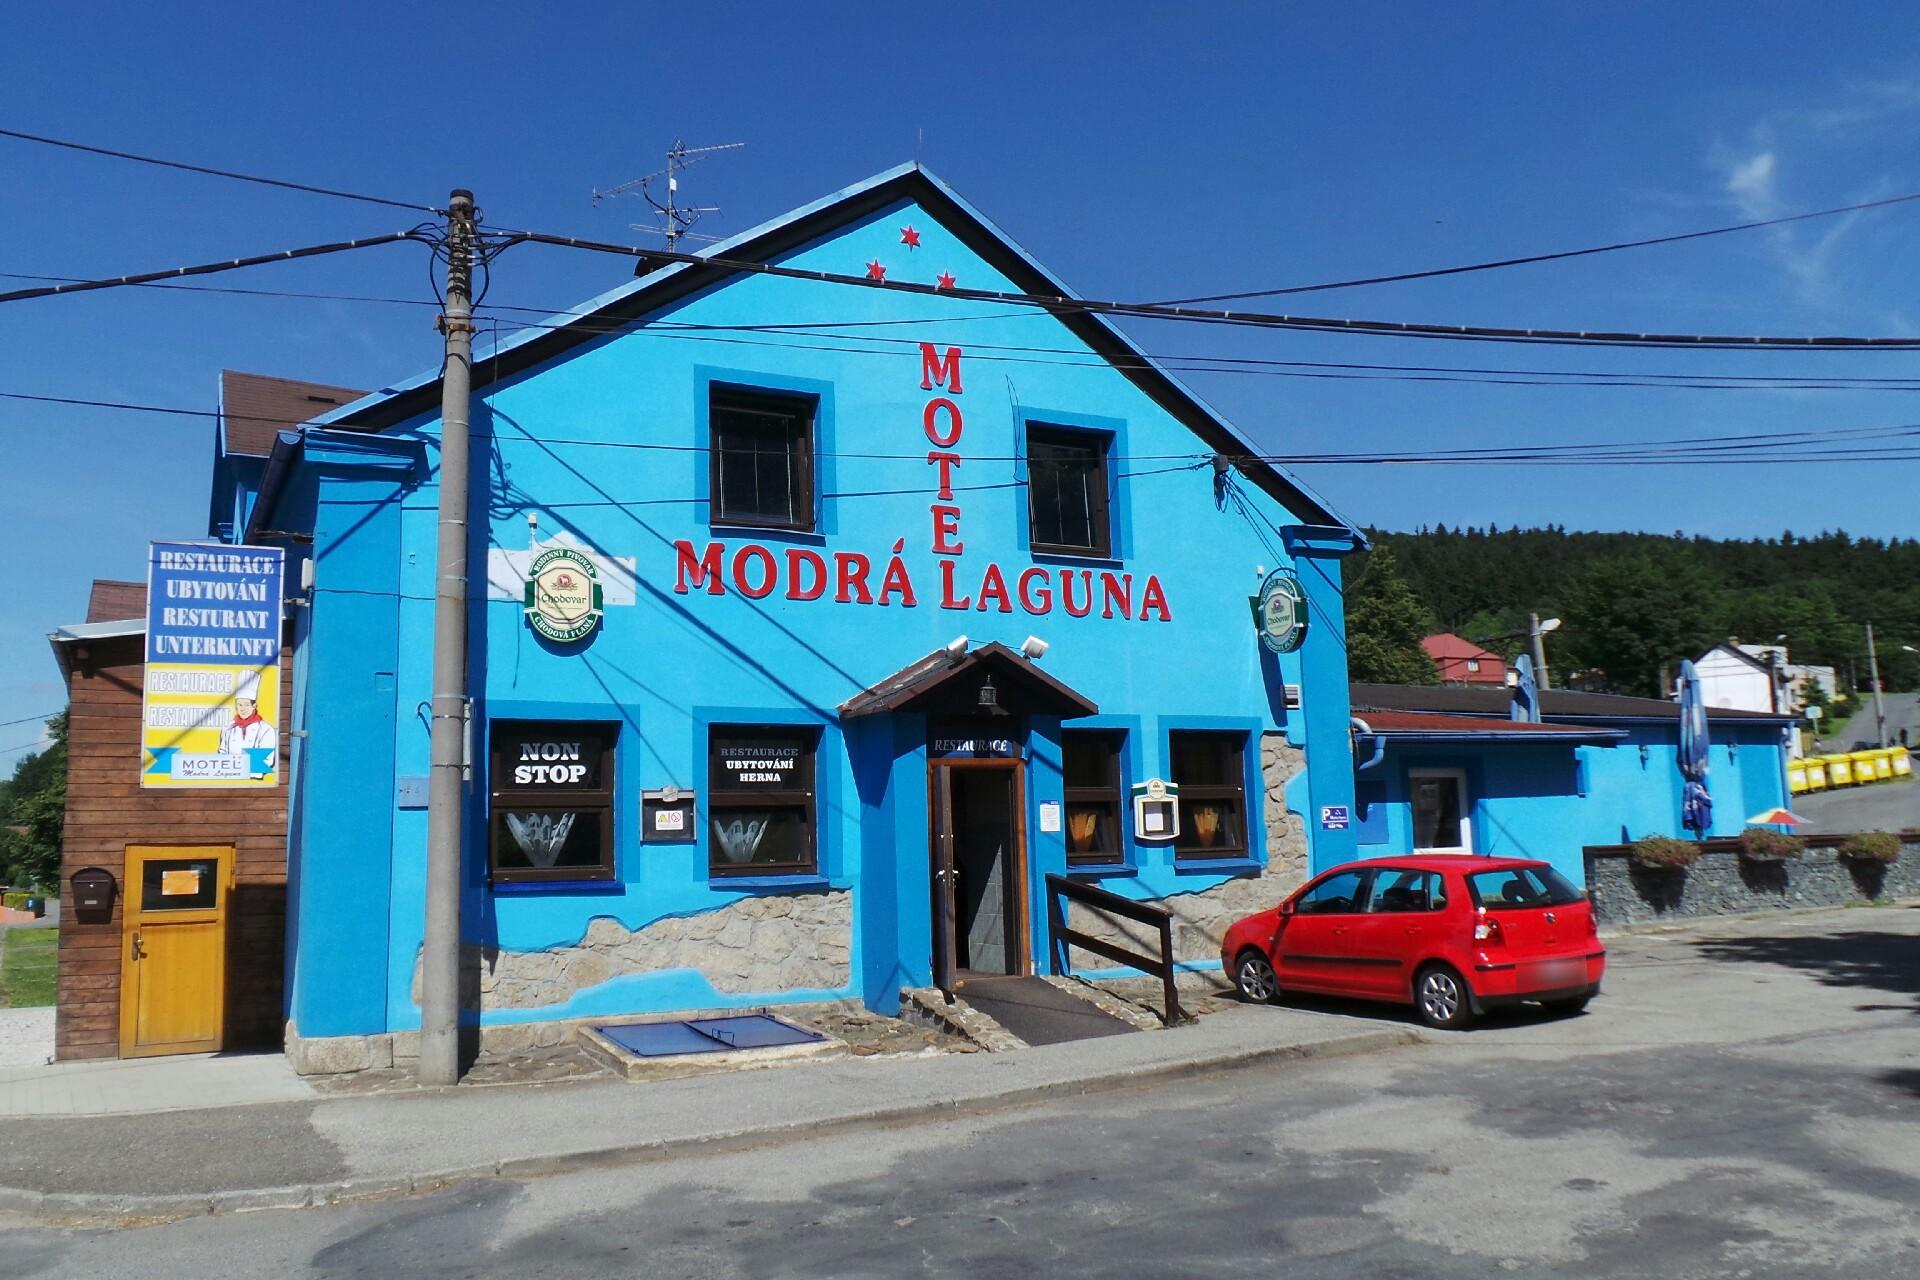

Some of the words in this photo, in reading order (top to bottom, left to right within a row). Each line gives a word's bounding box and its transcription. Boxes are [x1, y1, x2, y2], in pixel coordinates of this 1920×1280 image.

[919, 342, 970, 610] MOTEL
[159, 551, 274, 574] RESTAURACE
[567, 551, 594, 574] PIVOVAR
[673, 537, 917, 607] MODRÁ
[939, 560, 1172, 621] LAGUNA
[166, 578, 267, 601] UBYTOVÁNÍ
[541, 593, 587, 604] Chodovar
[163, 607, 269, 629] RESTURANT
[534, 616, 569, 639] CHODOVÁ
[155, 635, 275, 657] UNTERKUNFT
[151, 672, 232, 693] RESTAURACE
[149, 707, 231, 727] RESTAURANT
[520, 743, 580, 761] NON
[720, 748, 799, 757] RESTAURACE
[934, 739, 1008, 752] RESTAURACE
[182, 759, 242, 769] MOTEL
[726, 758, 794, 769] UBYTOVÁNÍ
[515, 765, 586, 784] STOP
[740, 773, 782, 782] HERNA
